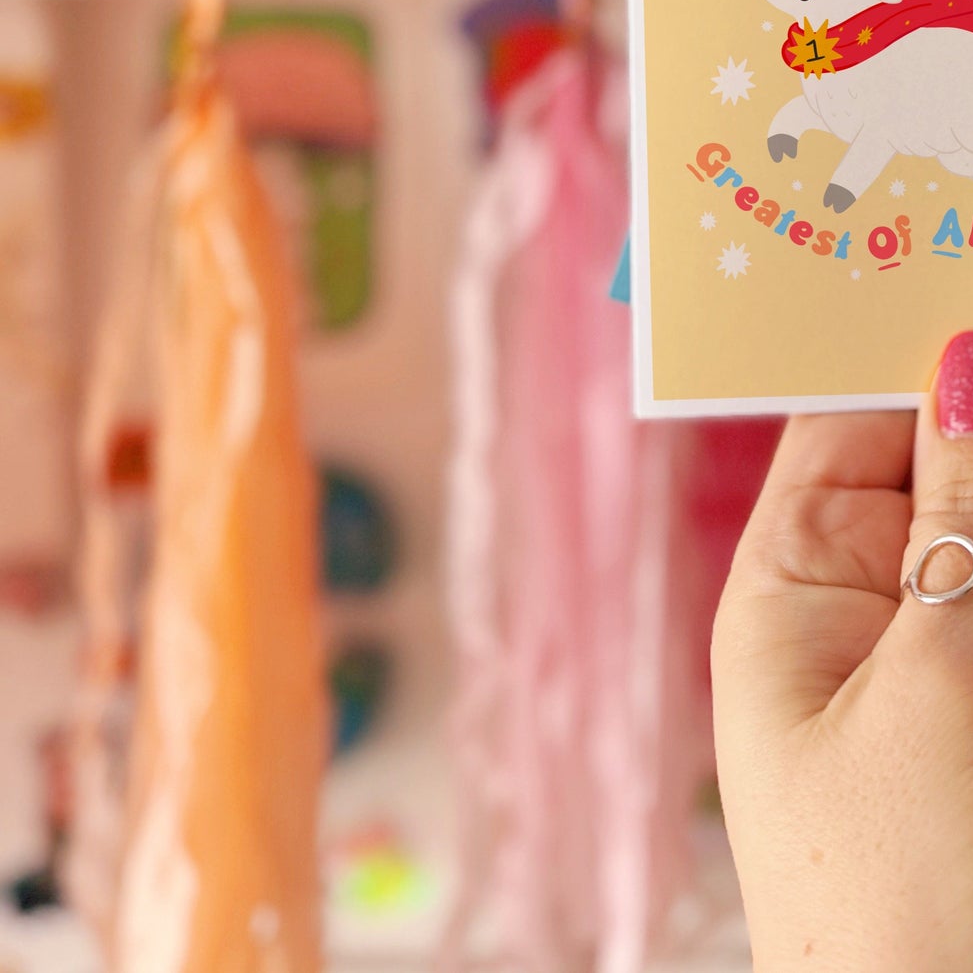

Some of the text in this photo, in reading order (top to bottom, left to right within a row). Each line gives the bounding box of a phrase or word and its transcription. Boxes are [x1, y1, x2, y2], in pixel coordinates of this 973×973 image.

[804, 38, 826, 63] 1
[695, 142, 851, 259] Greatest
[868, 214, 912, 260] Of
